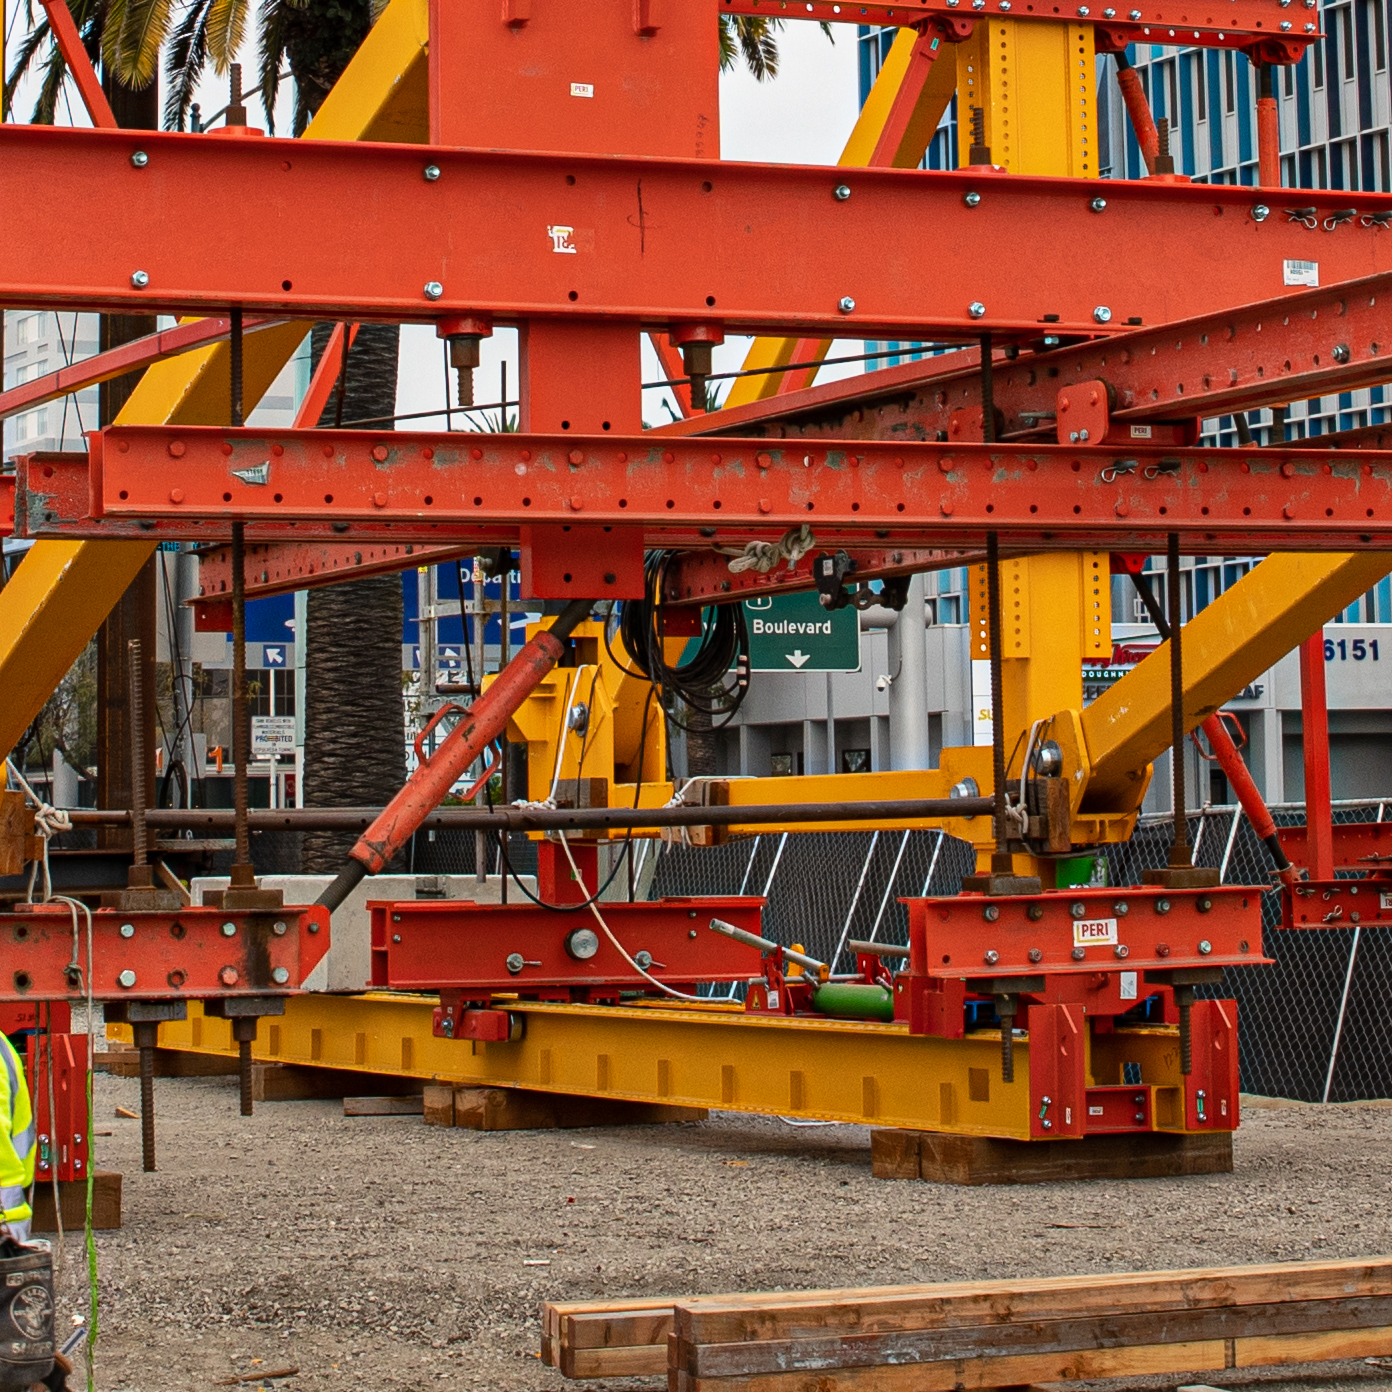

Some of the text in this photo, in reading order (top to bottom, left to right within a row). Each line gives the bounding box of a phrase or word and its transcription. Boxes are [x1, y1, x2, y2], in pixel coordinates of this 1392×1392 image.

[753, 618, 831, 634] Boulevard
[1324, 639, 1379, 661] 6151
[255, 735, 293, 743] PROHIBITED
[1081, 922, 1109, 937] PERI
